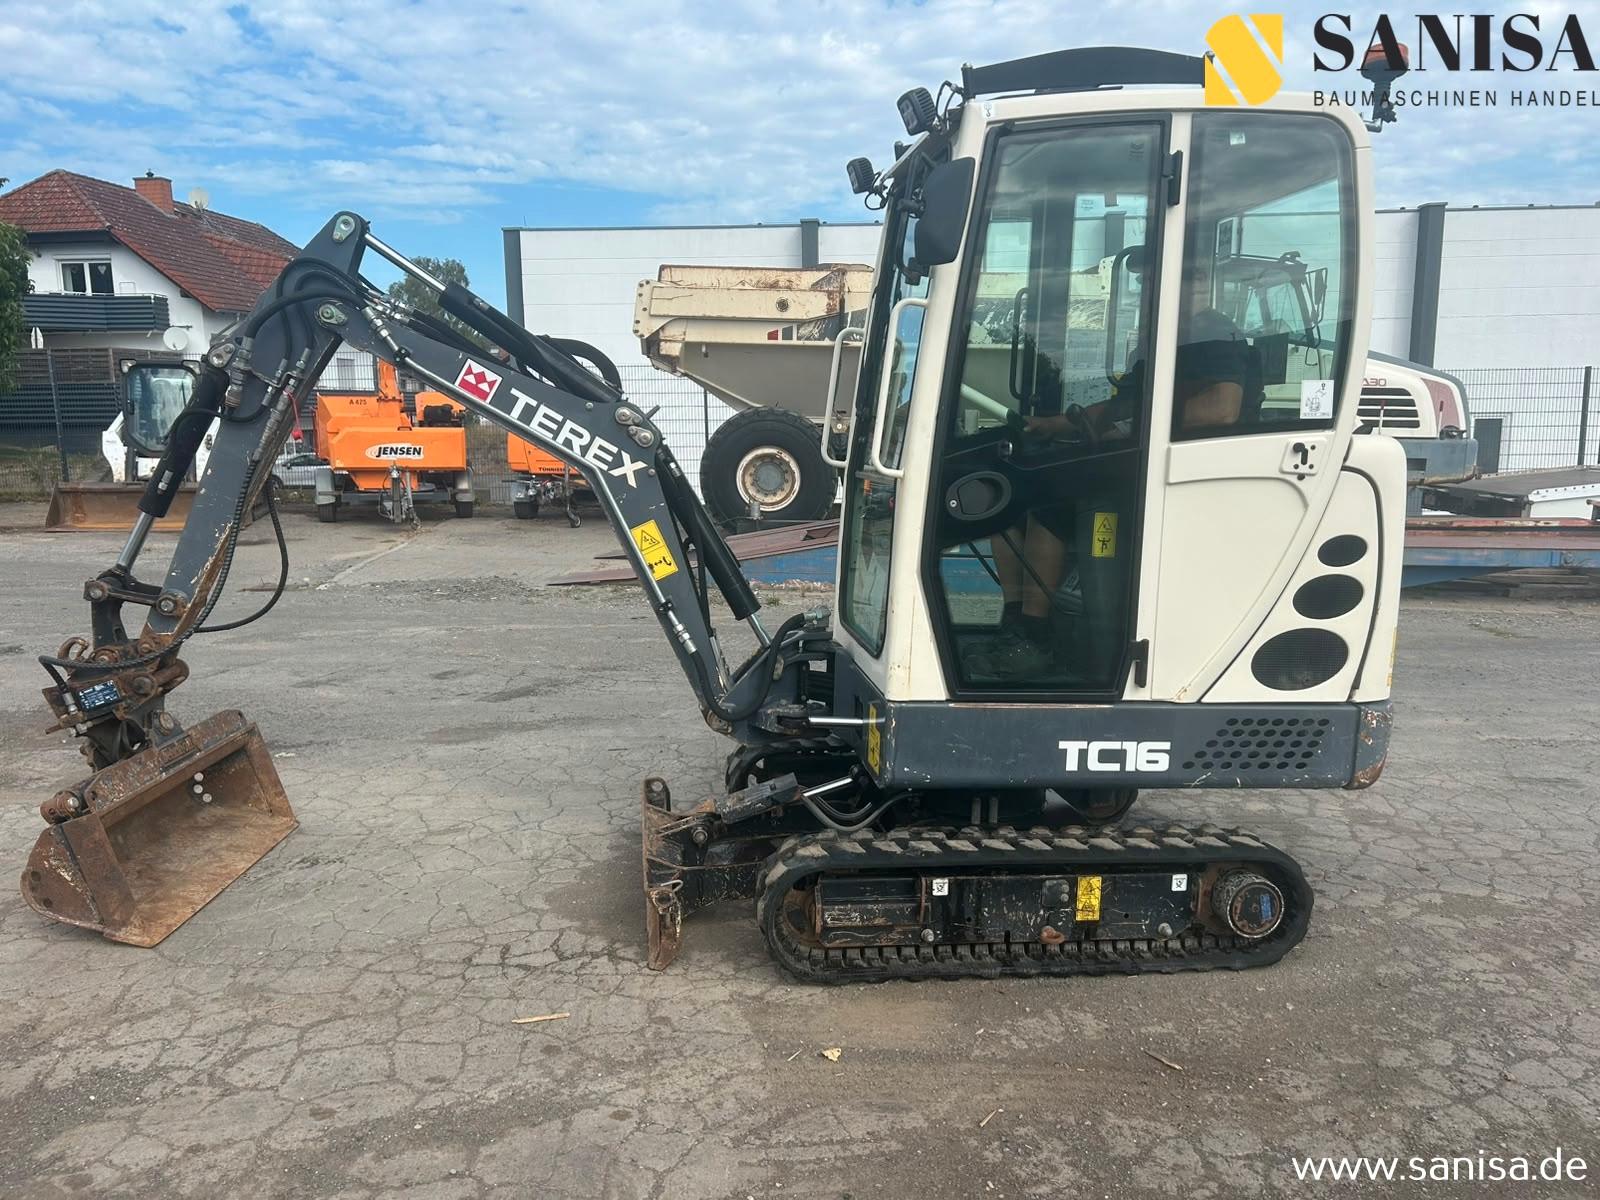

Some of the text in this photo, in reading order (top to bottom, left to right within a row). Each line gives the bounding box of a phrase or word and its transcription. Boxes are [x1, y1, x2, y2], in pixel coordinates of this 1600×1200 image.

[376, 446, 422, 458] JENSEN
[509, 387, 648, 488] TEREX
[1058, 740, 1171, 772] TC16
